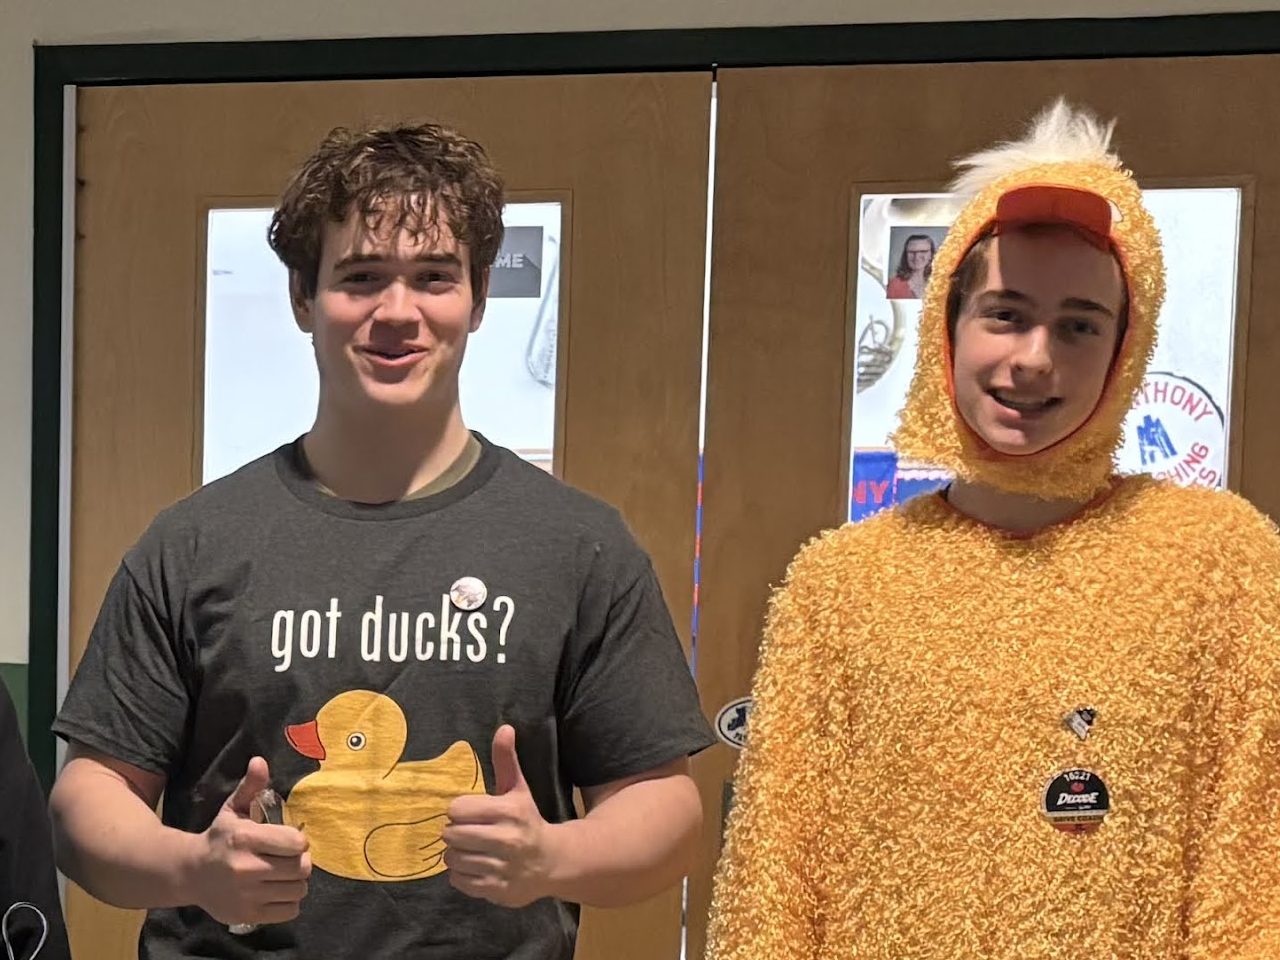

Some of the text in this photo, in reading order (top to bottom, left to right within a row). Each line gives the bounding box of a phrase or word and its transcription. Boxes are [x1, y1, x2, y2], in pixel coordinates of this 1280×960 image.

[494, 253, 524, 269] ME
[1140, 381, 1214, 422] THONY
[271, 593, 516, 673] got ducks?
[1063, 771, 1091, 782] 16221
